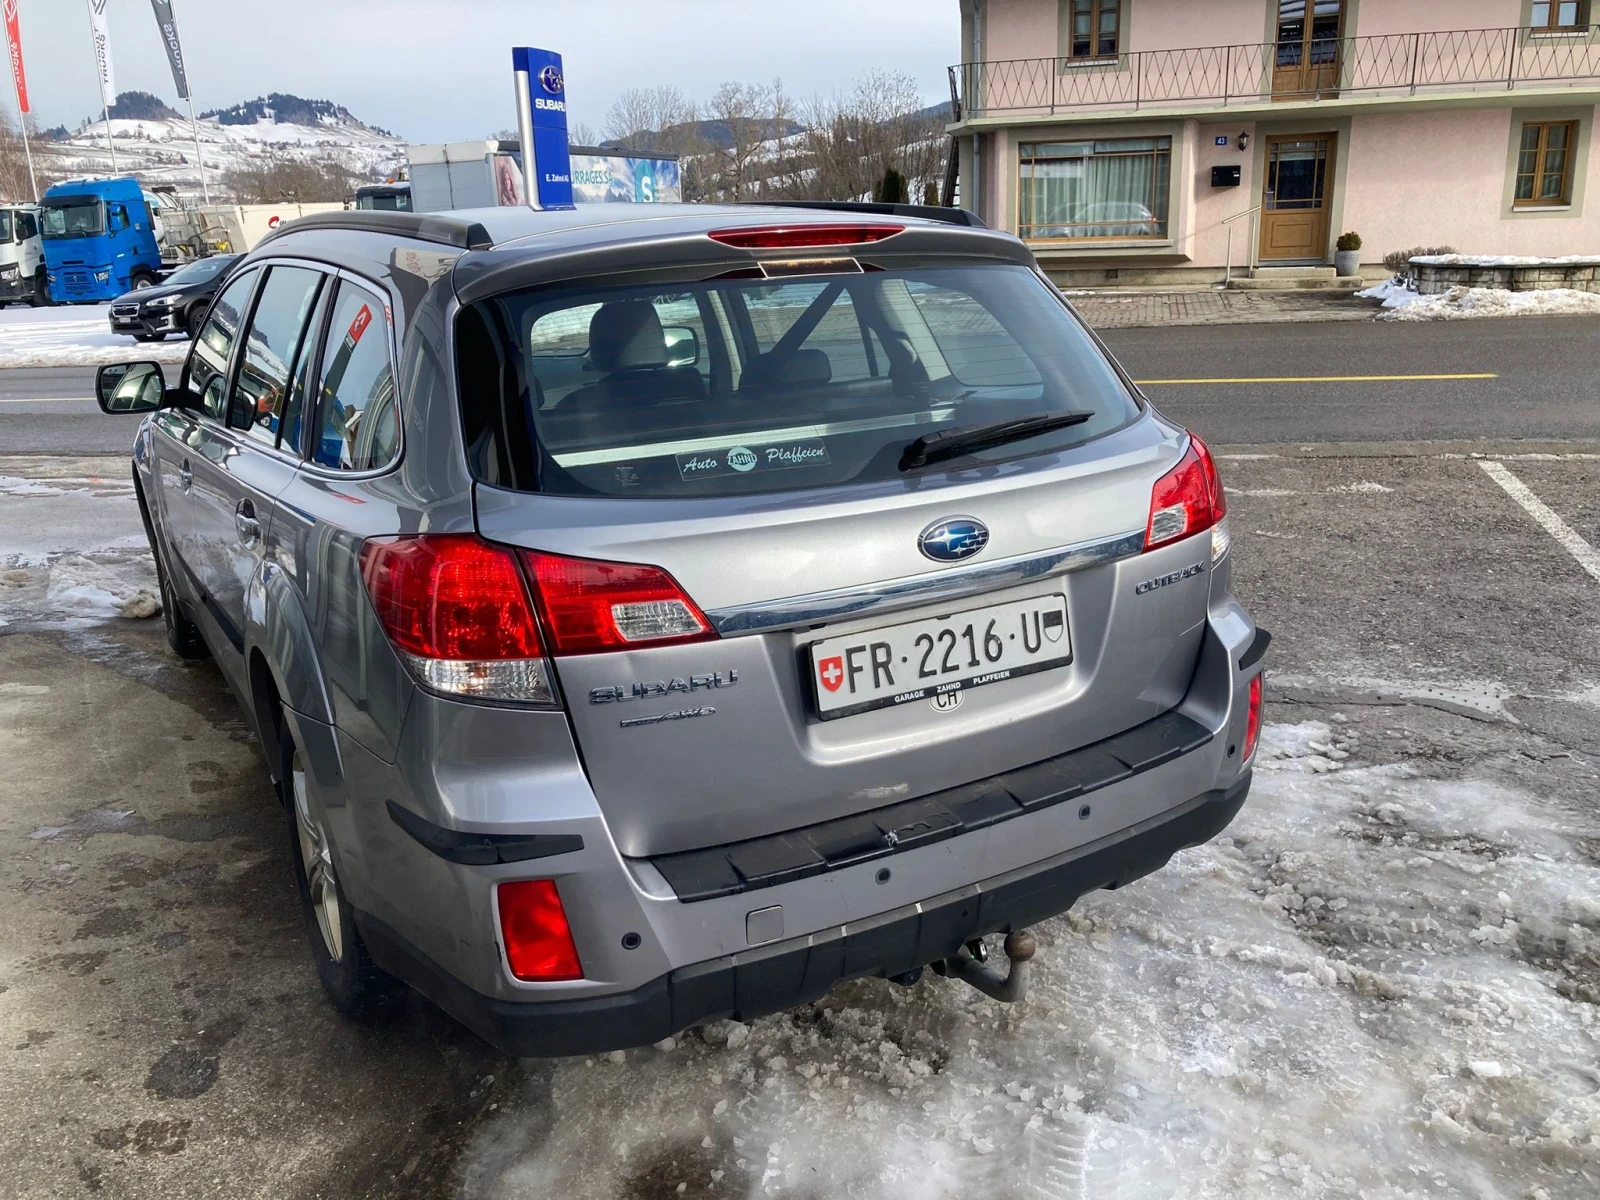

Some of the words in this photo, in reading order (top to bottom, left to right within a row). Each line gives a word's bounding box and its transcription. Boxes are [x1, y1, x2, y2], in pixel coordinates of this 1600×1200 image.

[683, 456, 718, 472] Auto
[727, 453, 758, 466] ZAHND
[765, 446, 826, 463] Plaffeien
[1136, 561, 1204, 595] OUTBACK
[589, 669, 738, 704] SUBARU
[894, 690, 925, 703] GARAGE
[936, 681, 961, 693] ZAHND
[973, 670, 1010, 685] PLAFFEIEN
[935, 690, 958, 708] CH
